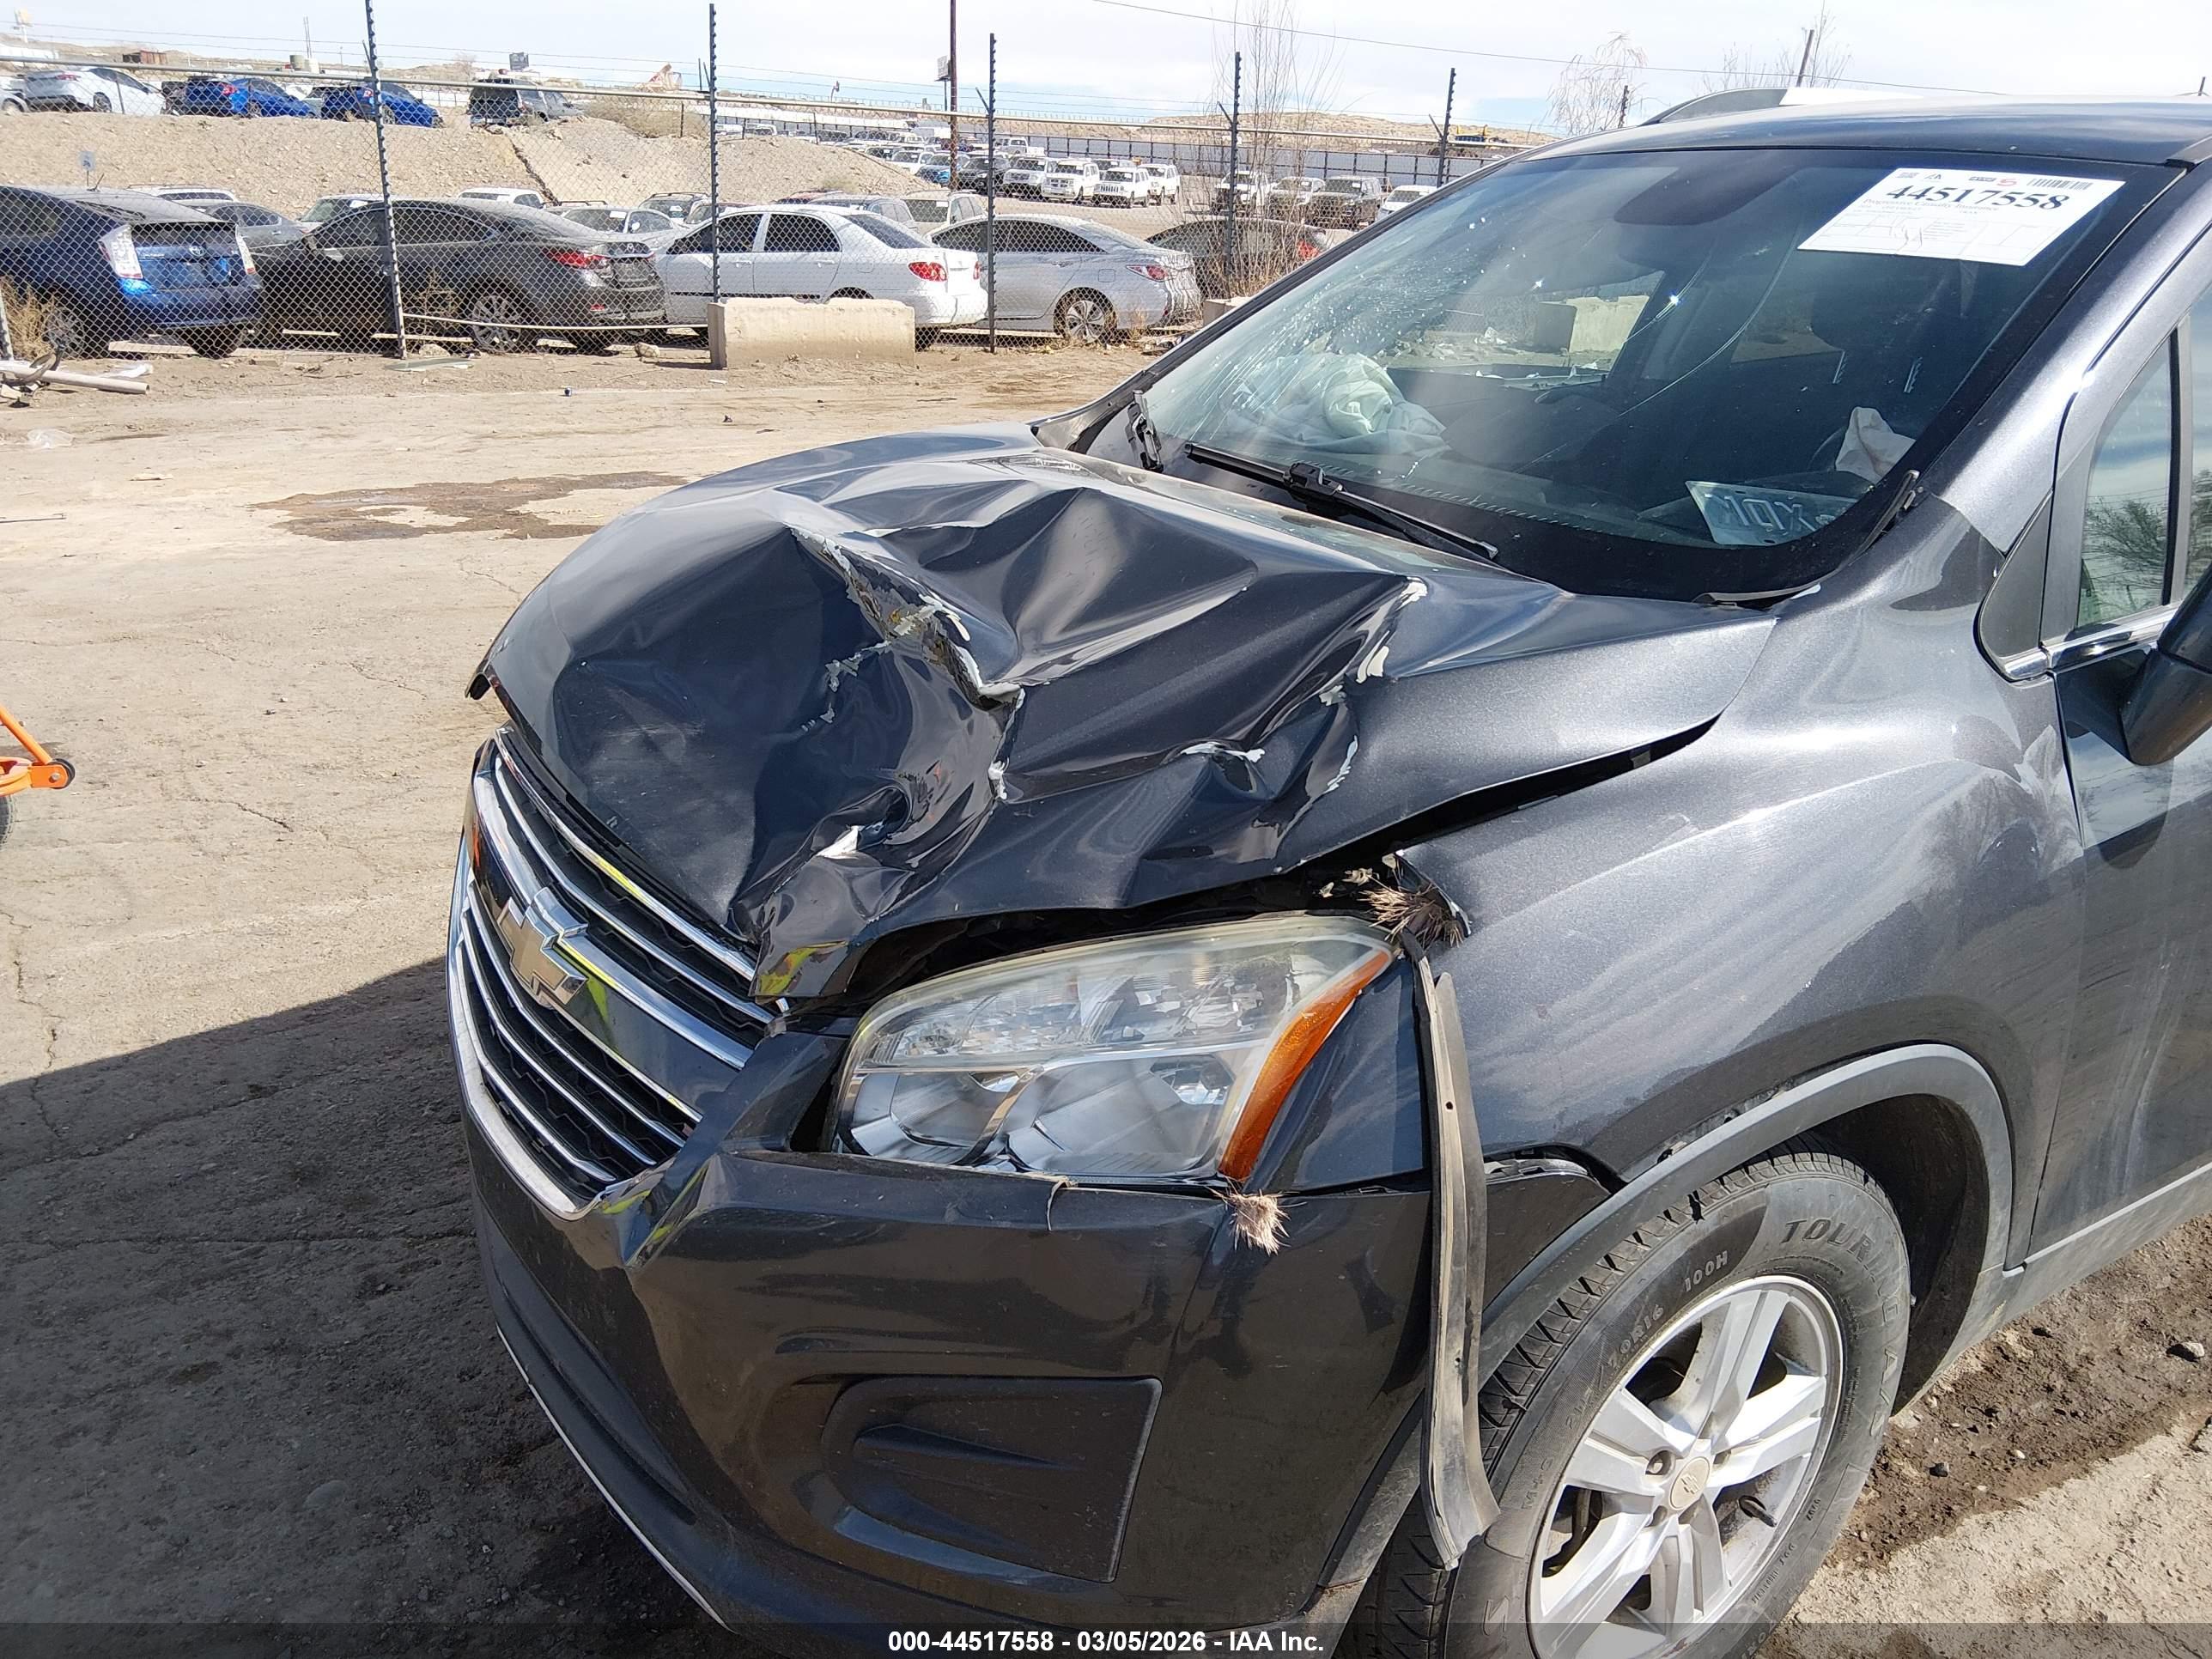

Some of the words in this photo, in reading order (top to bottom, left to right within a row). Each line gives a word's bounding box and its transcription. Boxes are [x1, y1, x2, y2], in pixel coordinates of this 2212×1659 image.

[1886, 185, 2070, 210] 44517558
[1683, 1249, 1729, 1292] 100H
[1779, 1218, 1899, 1327] TOURING
